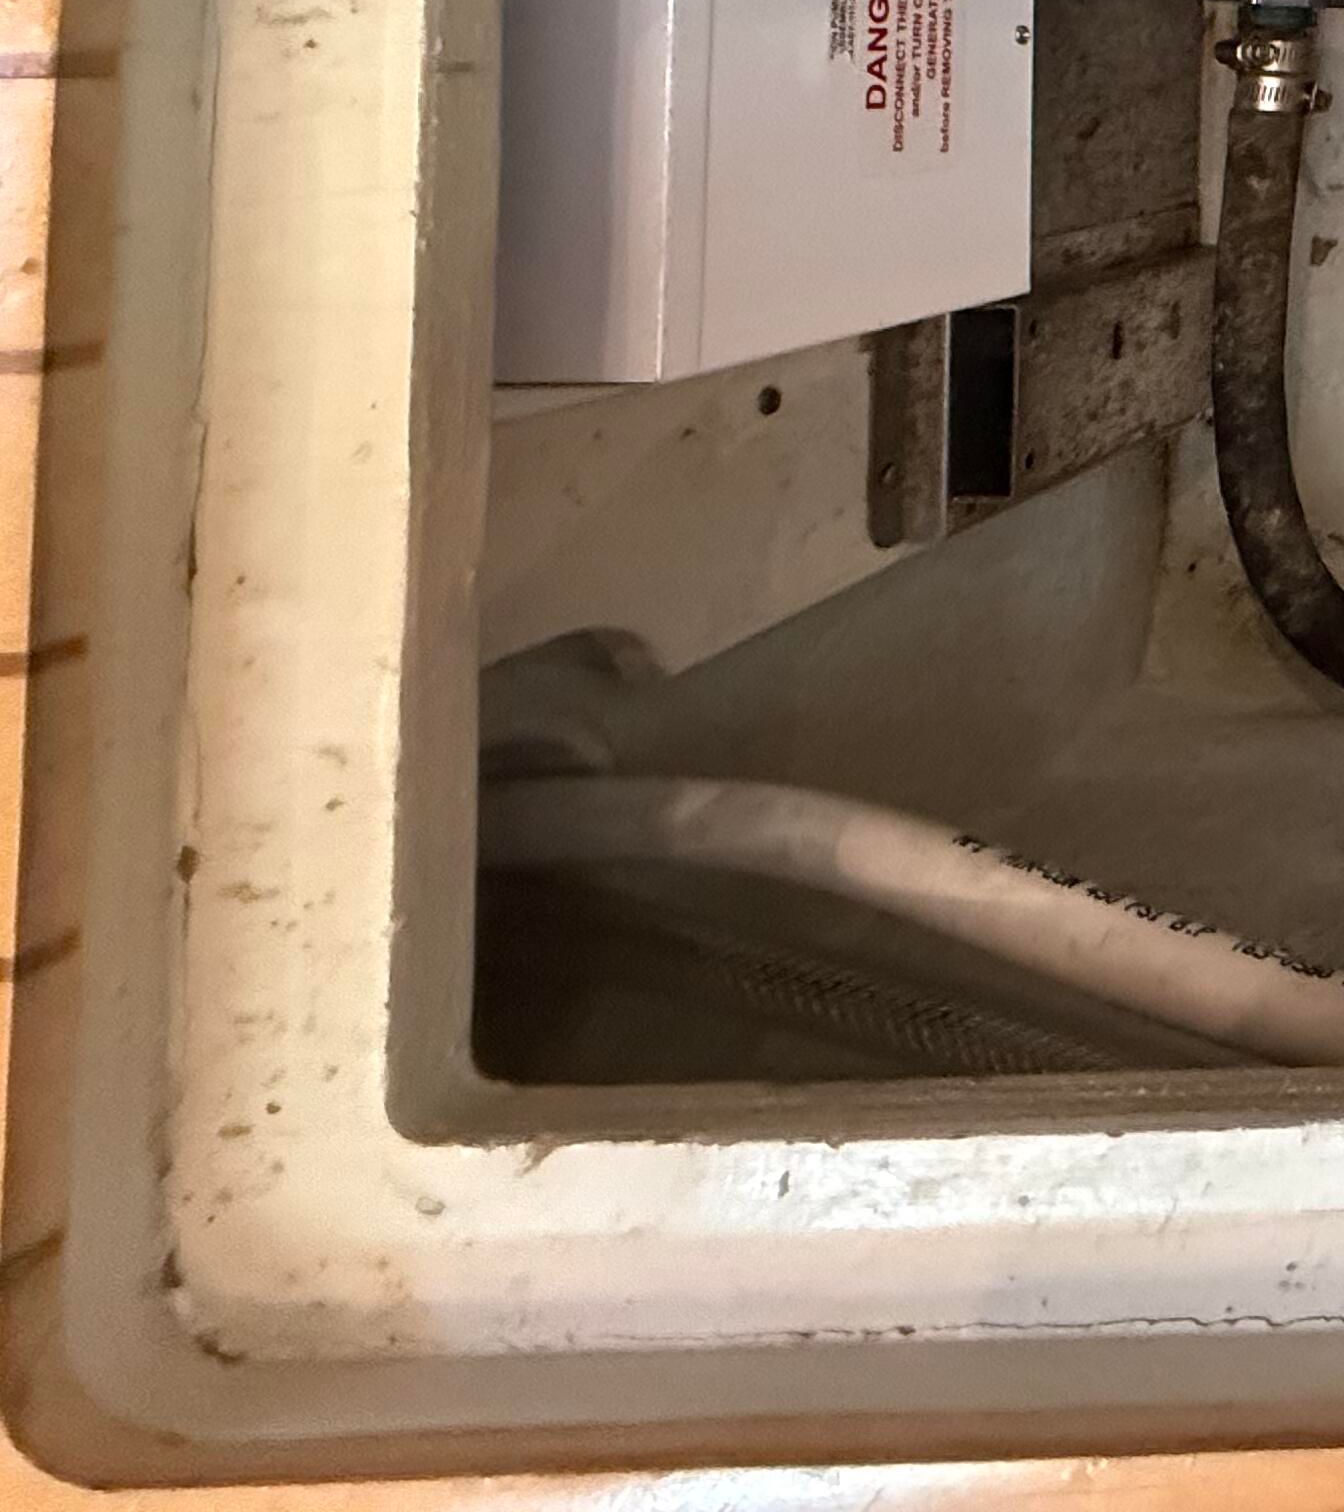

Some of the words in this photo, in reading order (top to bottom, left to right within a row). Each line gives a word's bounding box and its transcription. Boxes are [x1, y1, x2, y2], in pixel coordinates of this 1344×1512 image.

[896, 0, 908, 33] THE
[912, 12, 923, 60] TURN
[941, 9, 953, 98] REMOVING
[892, 39, 907, 153] DISCONNECT
[910, 65, 921, 118] and/or
[940, 102, 951, 153] before
